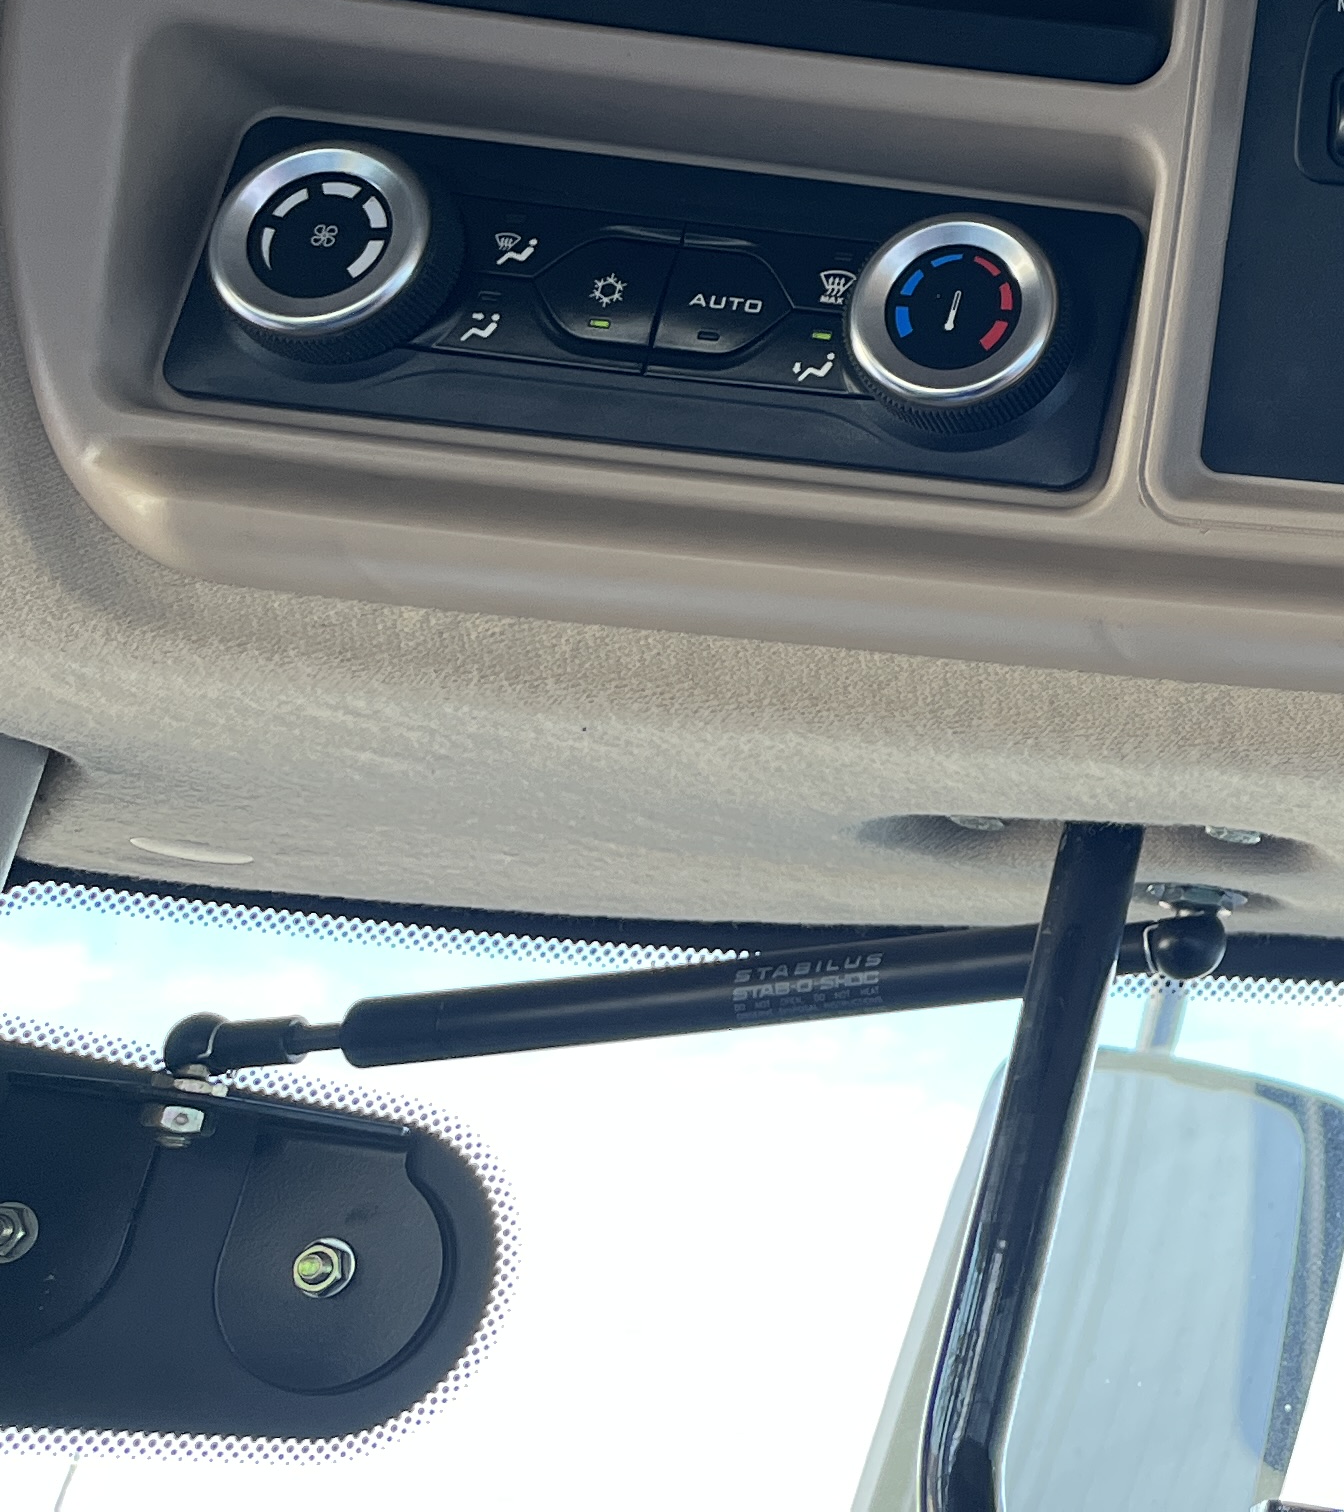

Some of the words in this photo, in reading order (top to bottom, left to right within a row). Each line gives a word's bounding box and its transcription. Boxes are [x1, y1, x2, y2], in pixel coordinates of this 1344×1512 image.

[689, 294, 763, 314] AUTO
[819, 295, 844, 305] MAX
[734, 953, 884, 983] STABILUS
